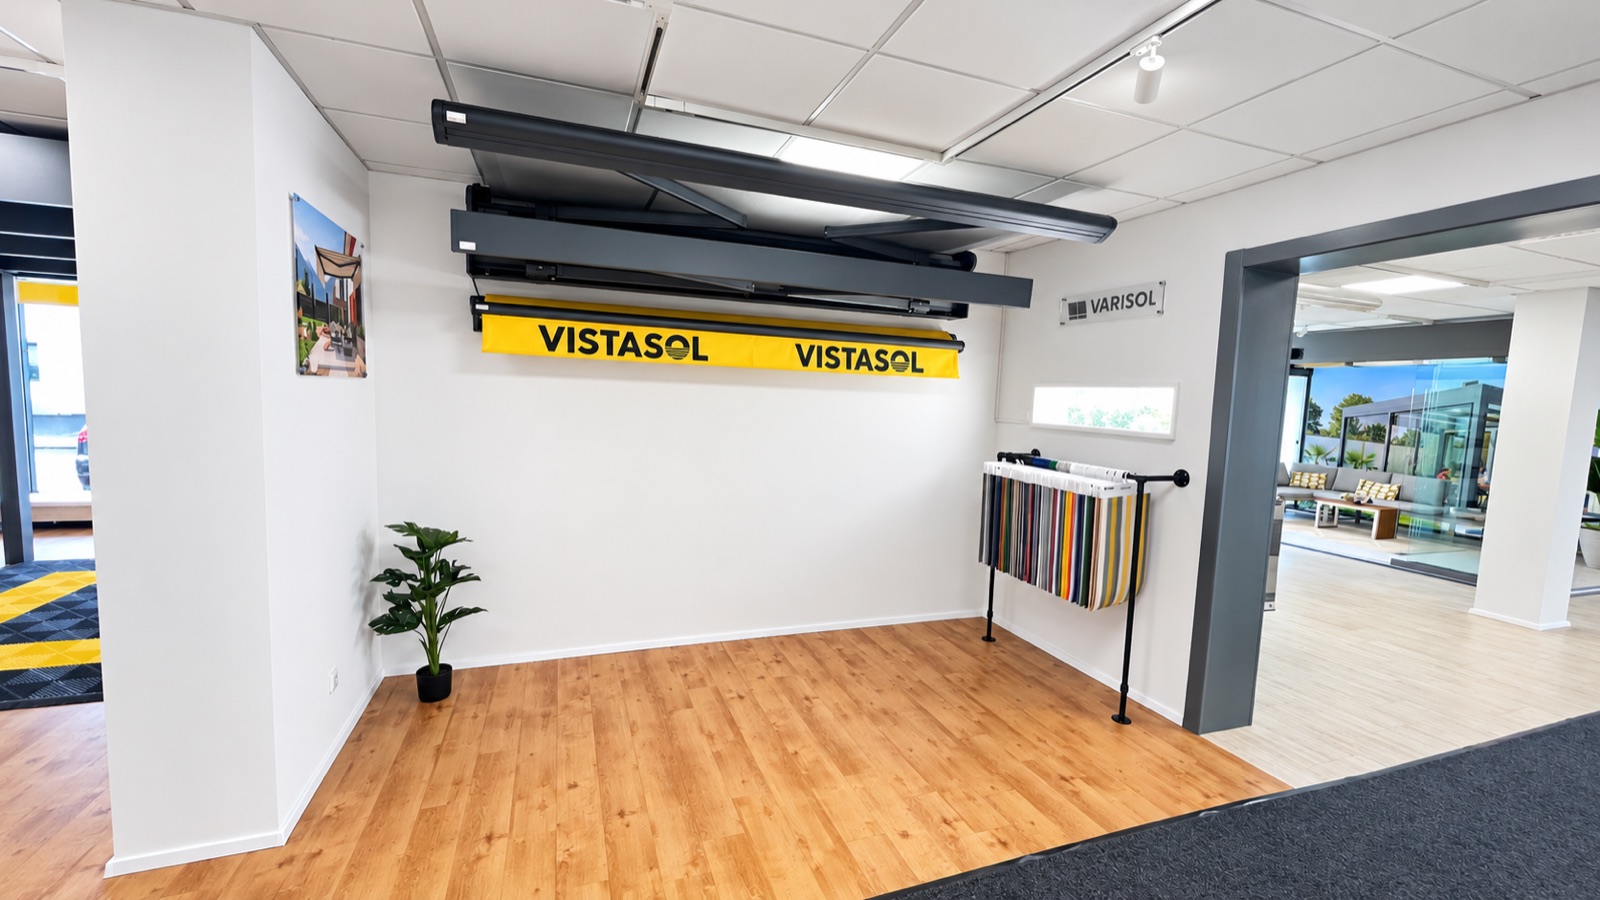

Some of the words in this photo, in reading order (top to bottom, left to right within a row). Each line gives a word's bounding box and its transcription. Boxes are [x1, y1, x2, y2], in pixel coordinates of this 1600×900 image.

[1091, 290, 1156, 314] VARISOL
[538, 325, 708, 361] VISTASOL
[795, 343, 924, 373] VISTASOL
